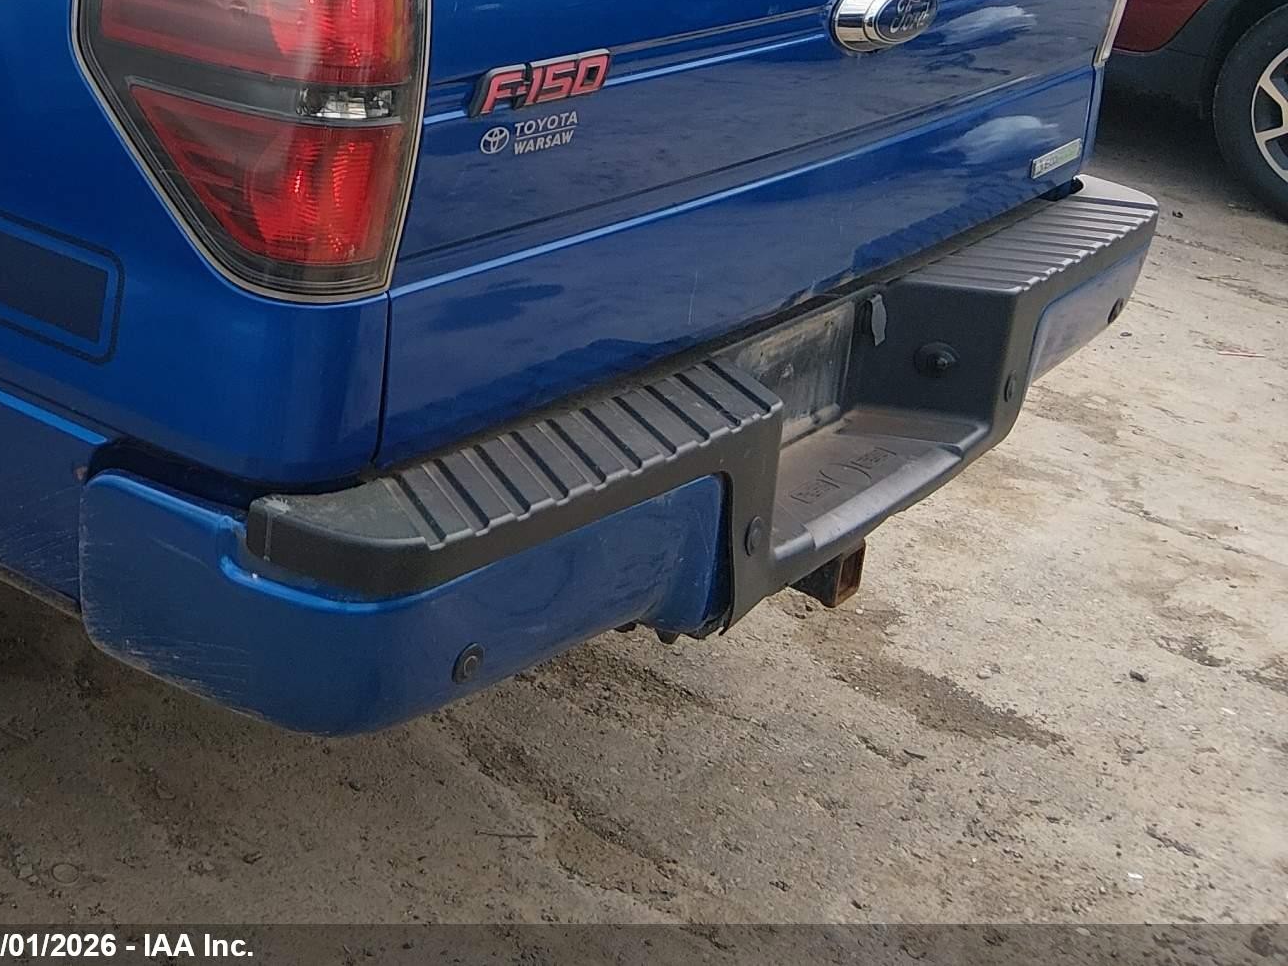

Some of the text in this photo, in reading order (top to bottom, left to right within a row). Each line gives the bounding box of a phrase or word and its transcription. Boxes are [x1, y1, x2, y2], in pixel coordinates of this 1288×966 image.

[470, 48, 611, 117] F-150
[514, 110, 578, 136] TOYOTA
[514, 130, 574, 155] WARSAW
